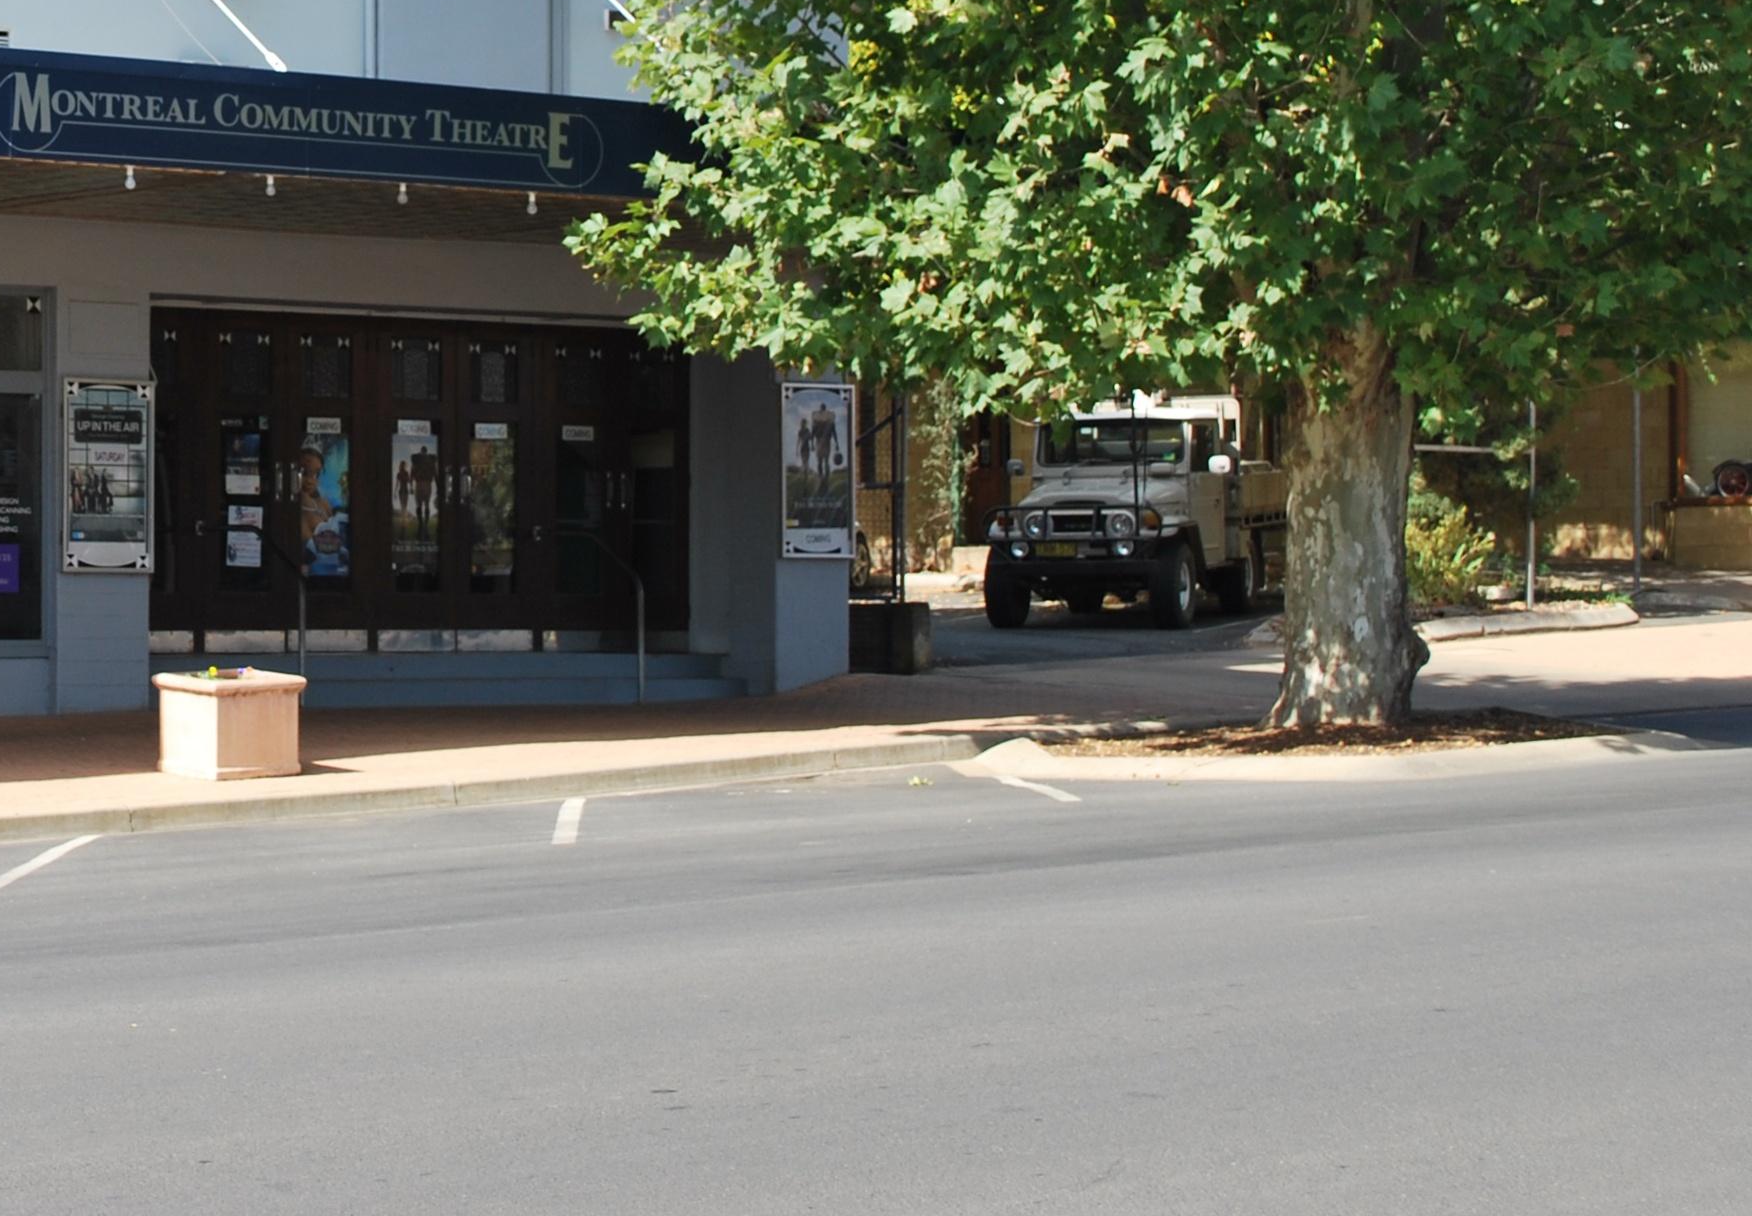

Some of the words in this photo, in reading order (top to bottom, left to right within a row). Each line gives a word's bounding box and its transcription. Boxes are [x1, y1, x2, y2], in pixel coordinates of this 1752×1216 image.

[76, 420, 90, 431] UP
[91, 420, 102, 432] IN
[103, 421, 122, 432] THE
[123, 421, 140, 433] AIR
